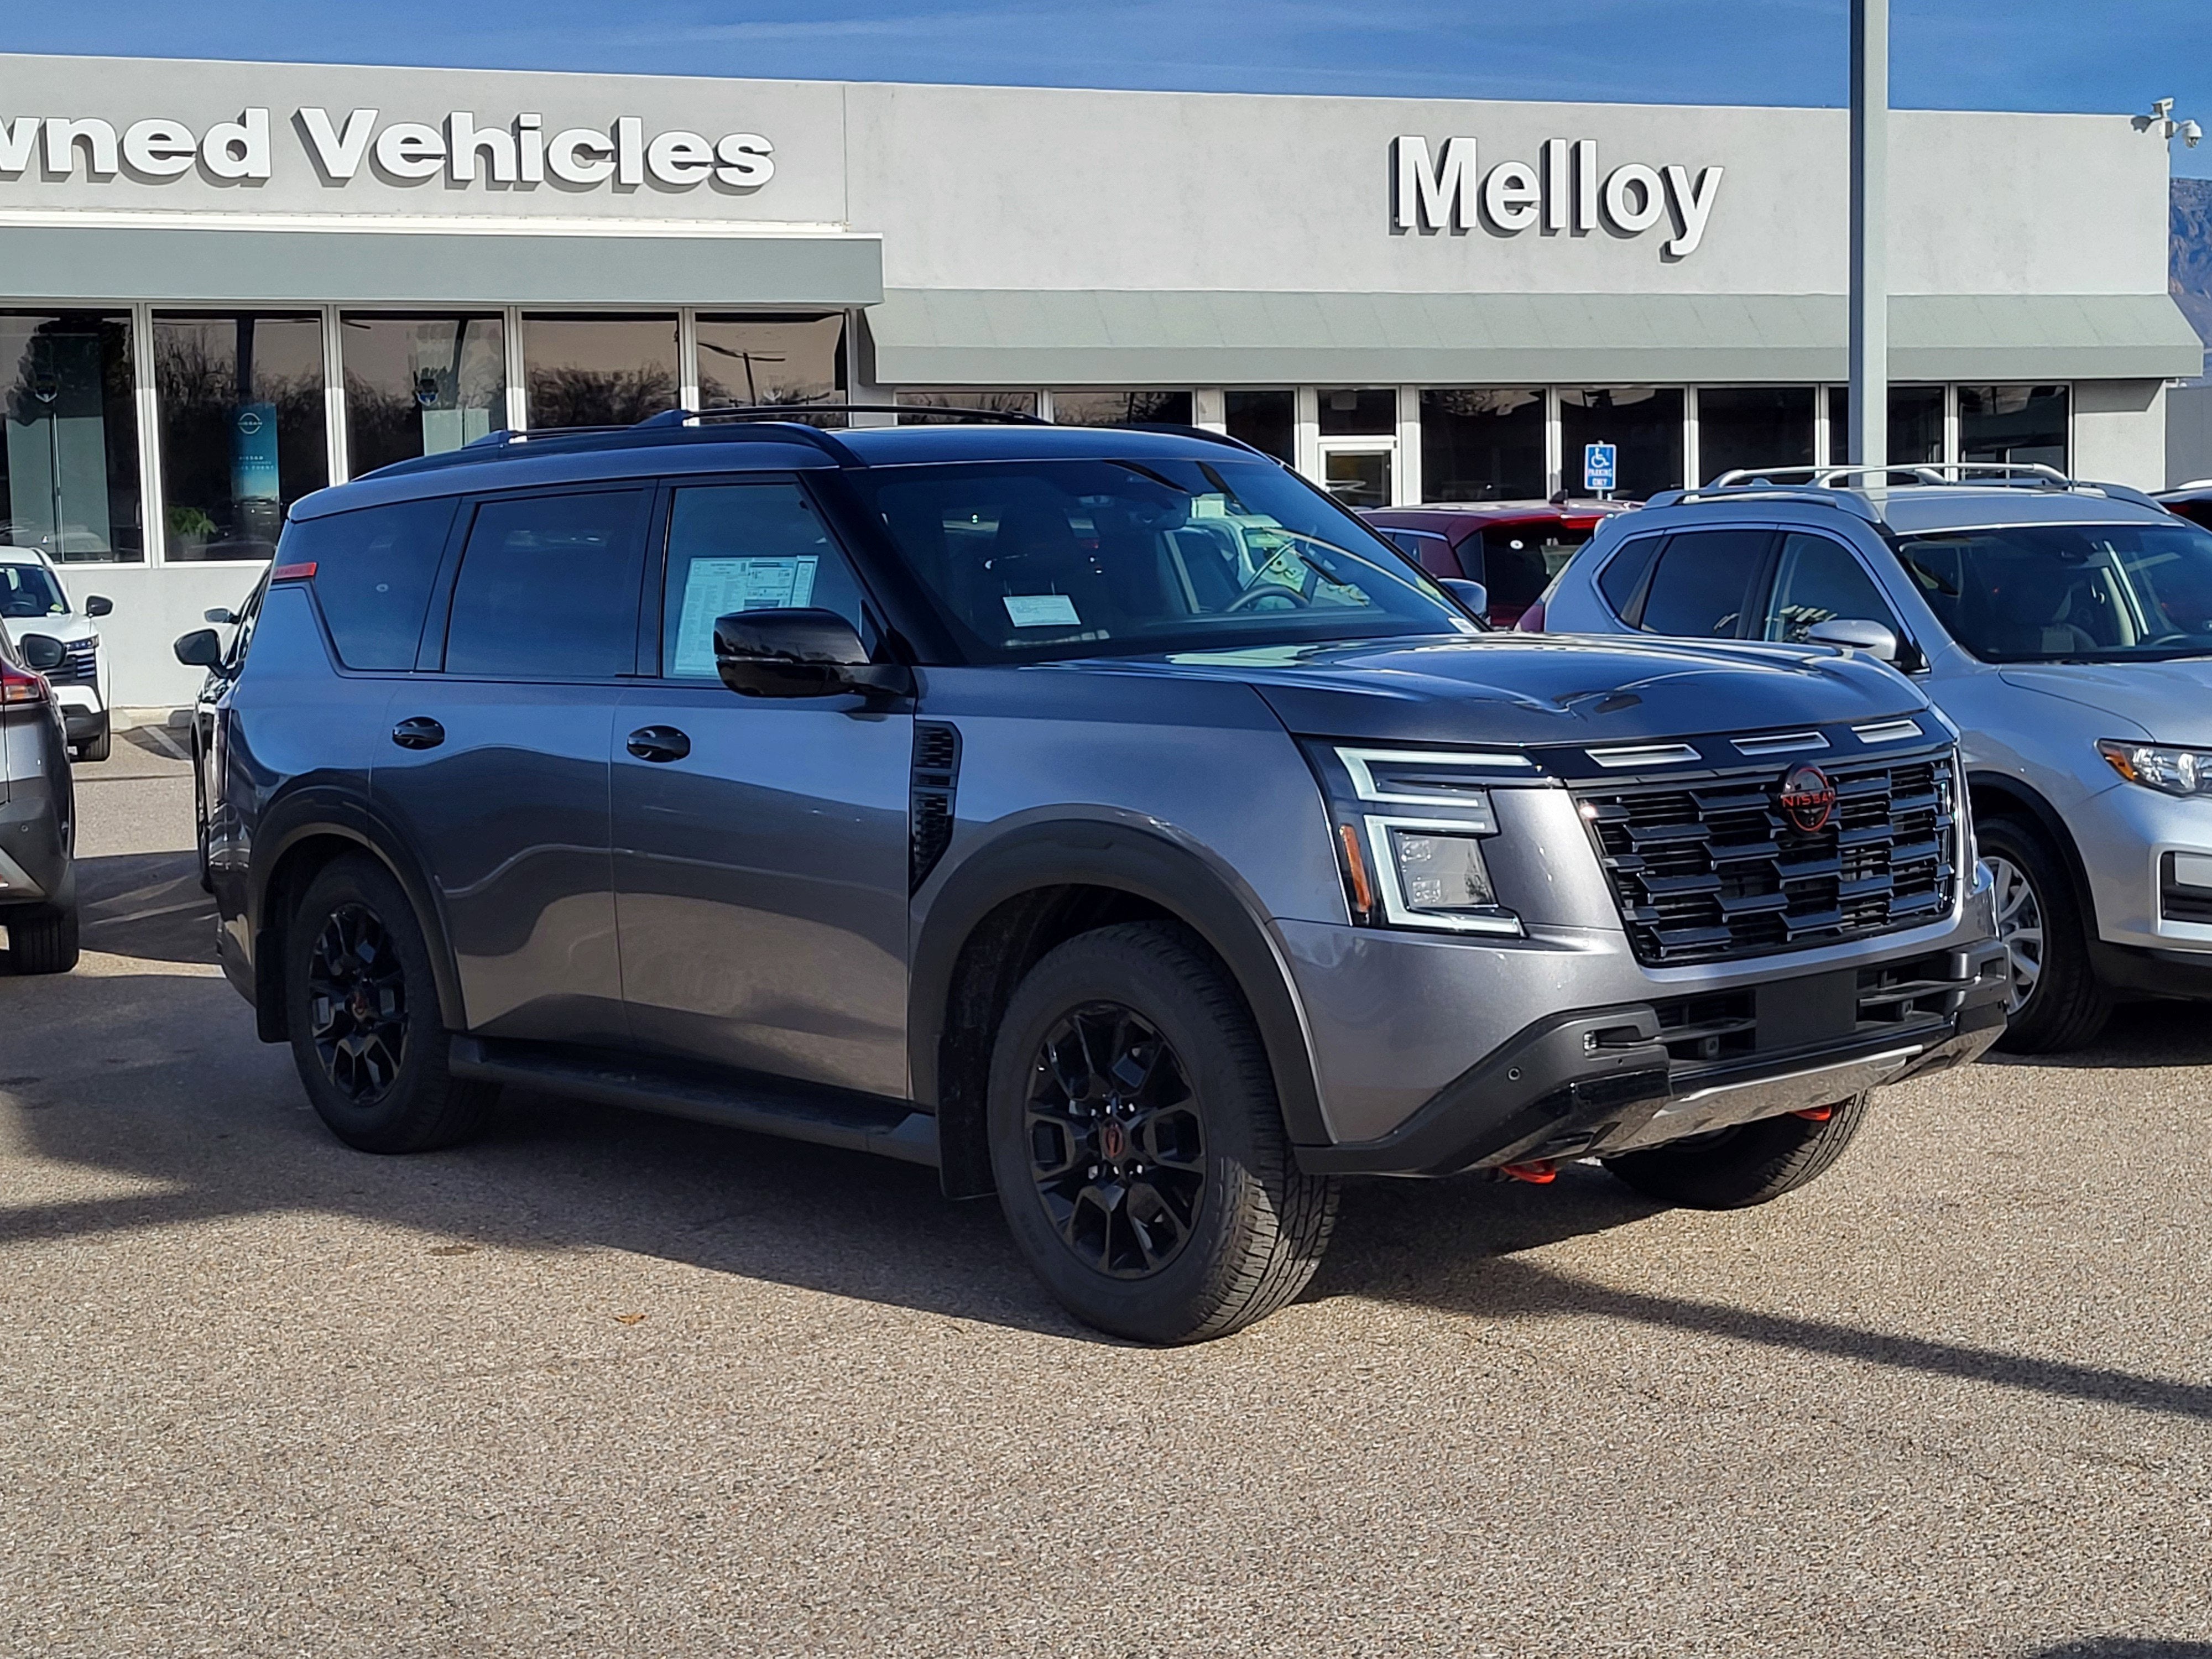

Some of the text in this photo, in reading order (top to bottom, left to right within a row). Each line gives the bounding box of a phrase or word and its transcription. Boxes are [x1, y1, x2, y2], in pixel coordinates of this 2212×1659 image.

[293, 107, 775, 194] Vehicles
[1389, 135, 1724, 262] Melloy
[1782, 791, 1835, 807] NISSAN
